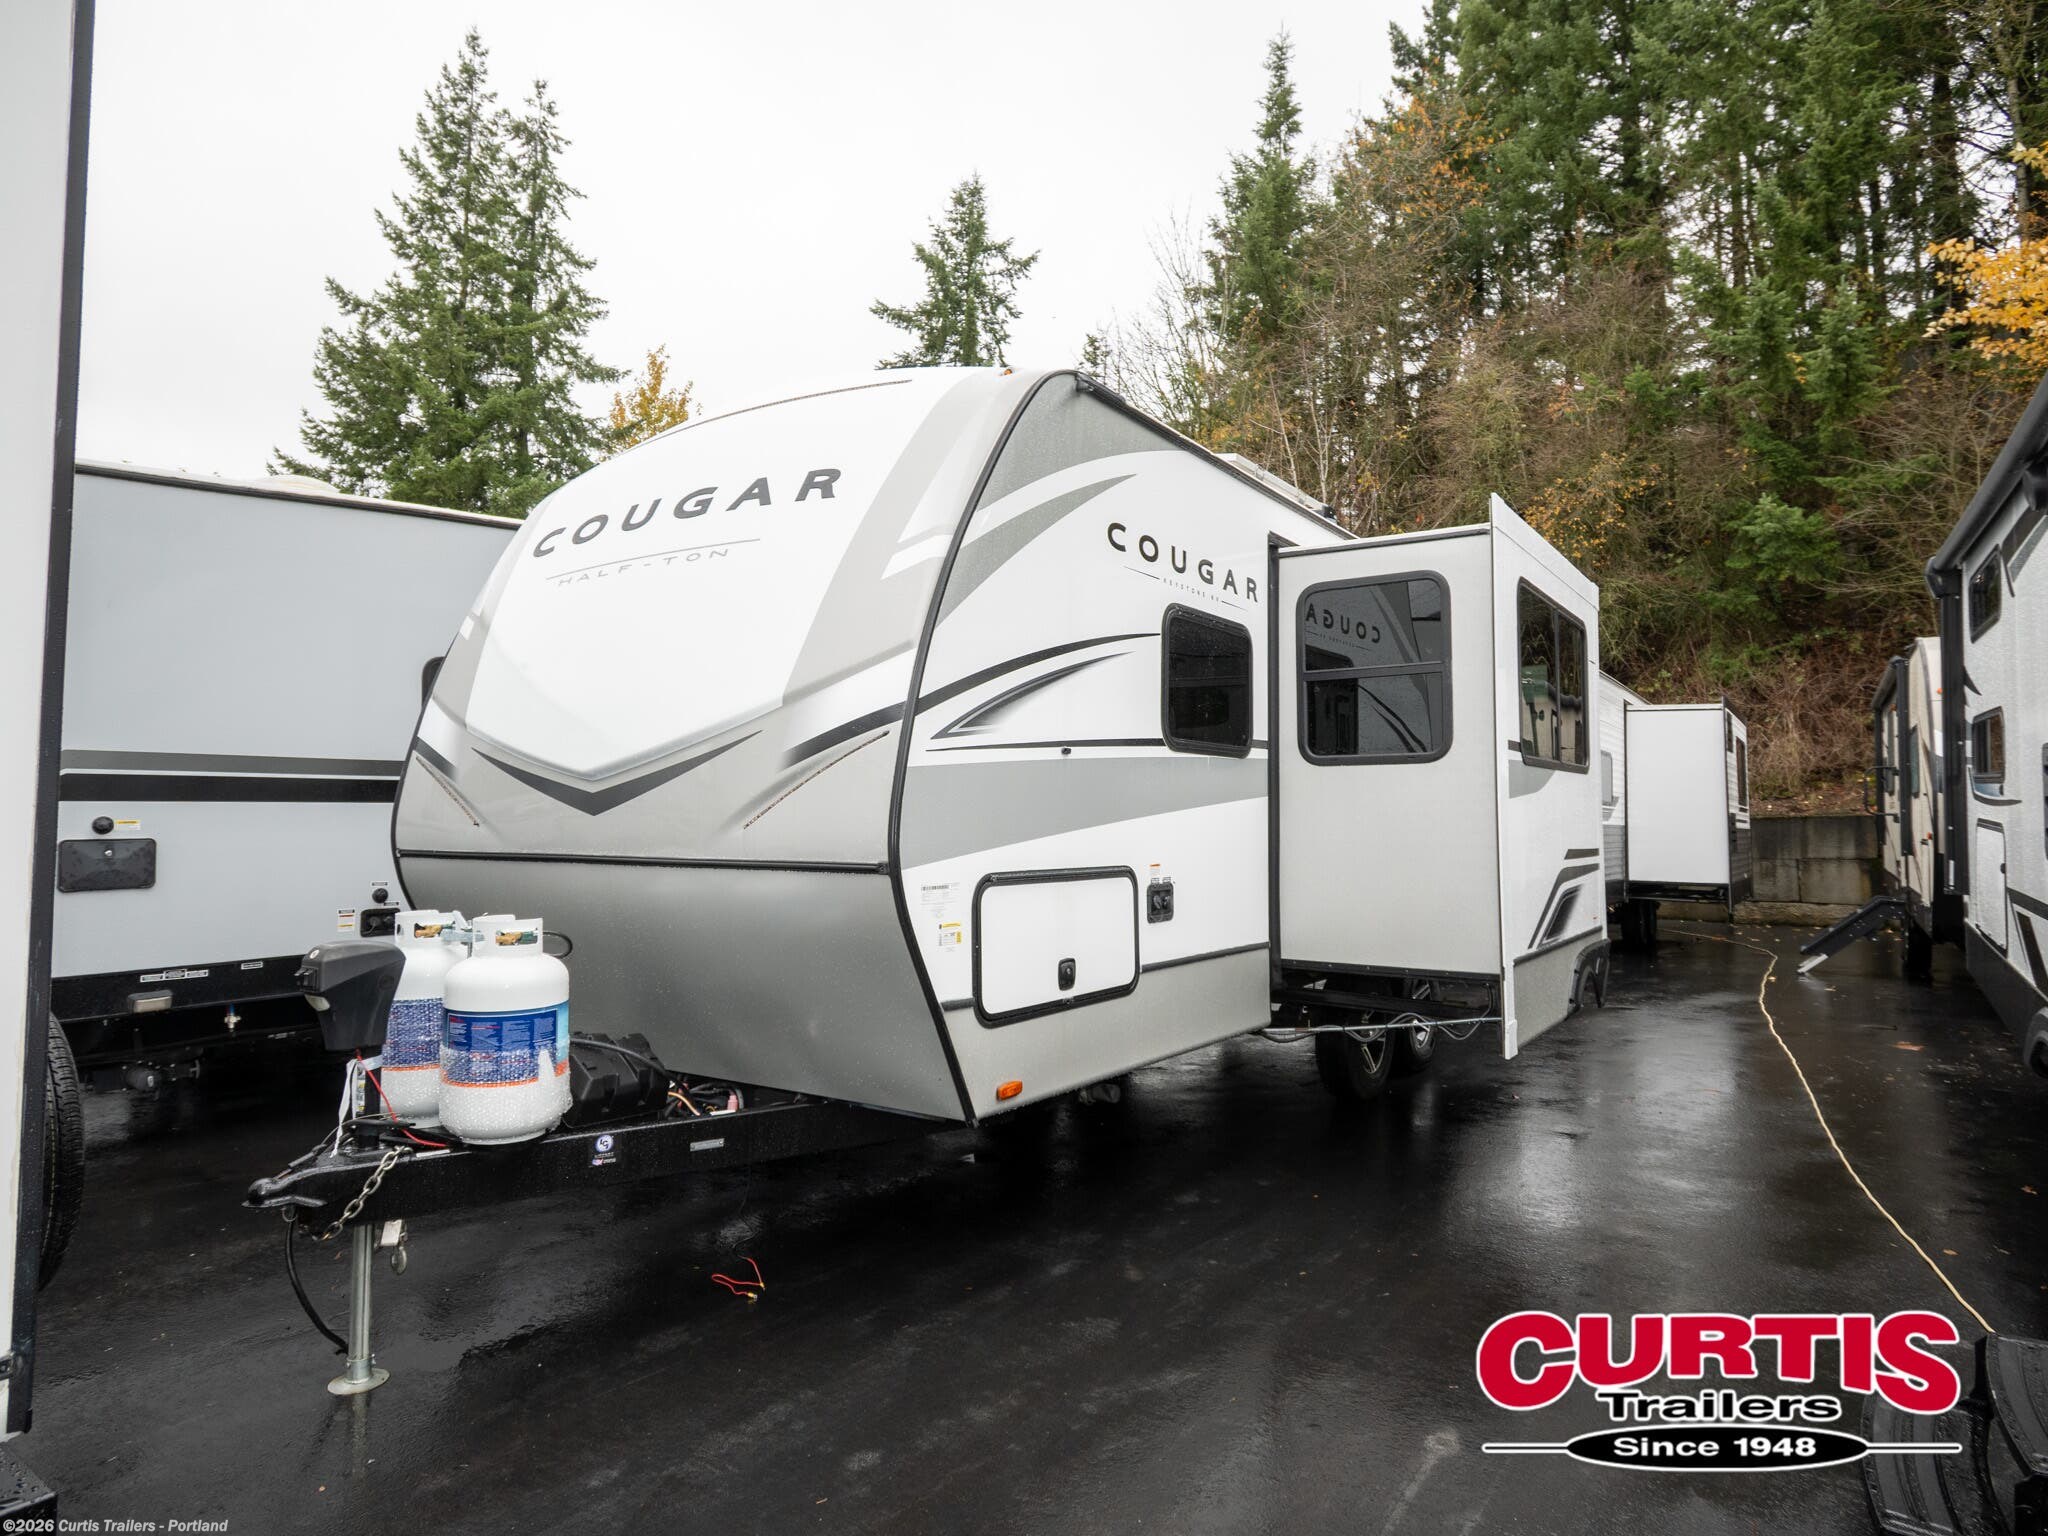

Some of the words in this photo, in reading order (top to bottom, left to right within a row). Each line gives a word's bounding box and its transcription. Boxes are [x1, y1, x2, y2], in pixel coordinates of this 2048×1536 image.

[533, 468, 842, 558] COUGAR
[558, 548, 729, 587] HALF-TON
[1107, 522, 1258, 603] COUGAR
